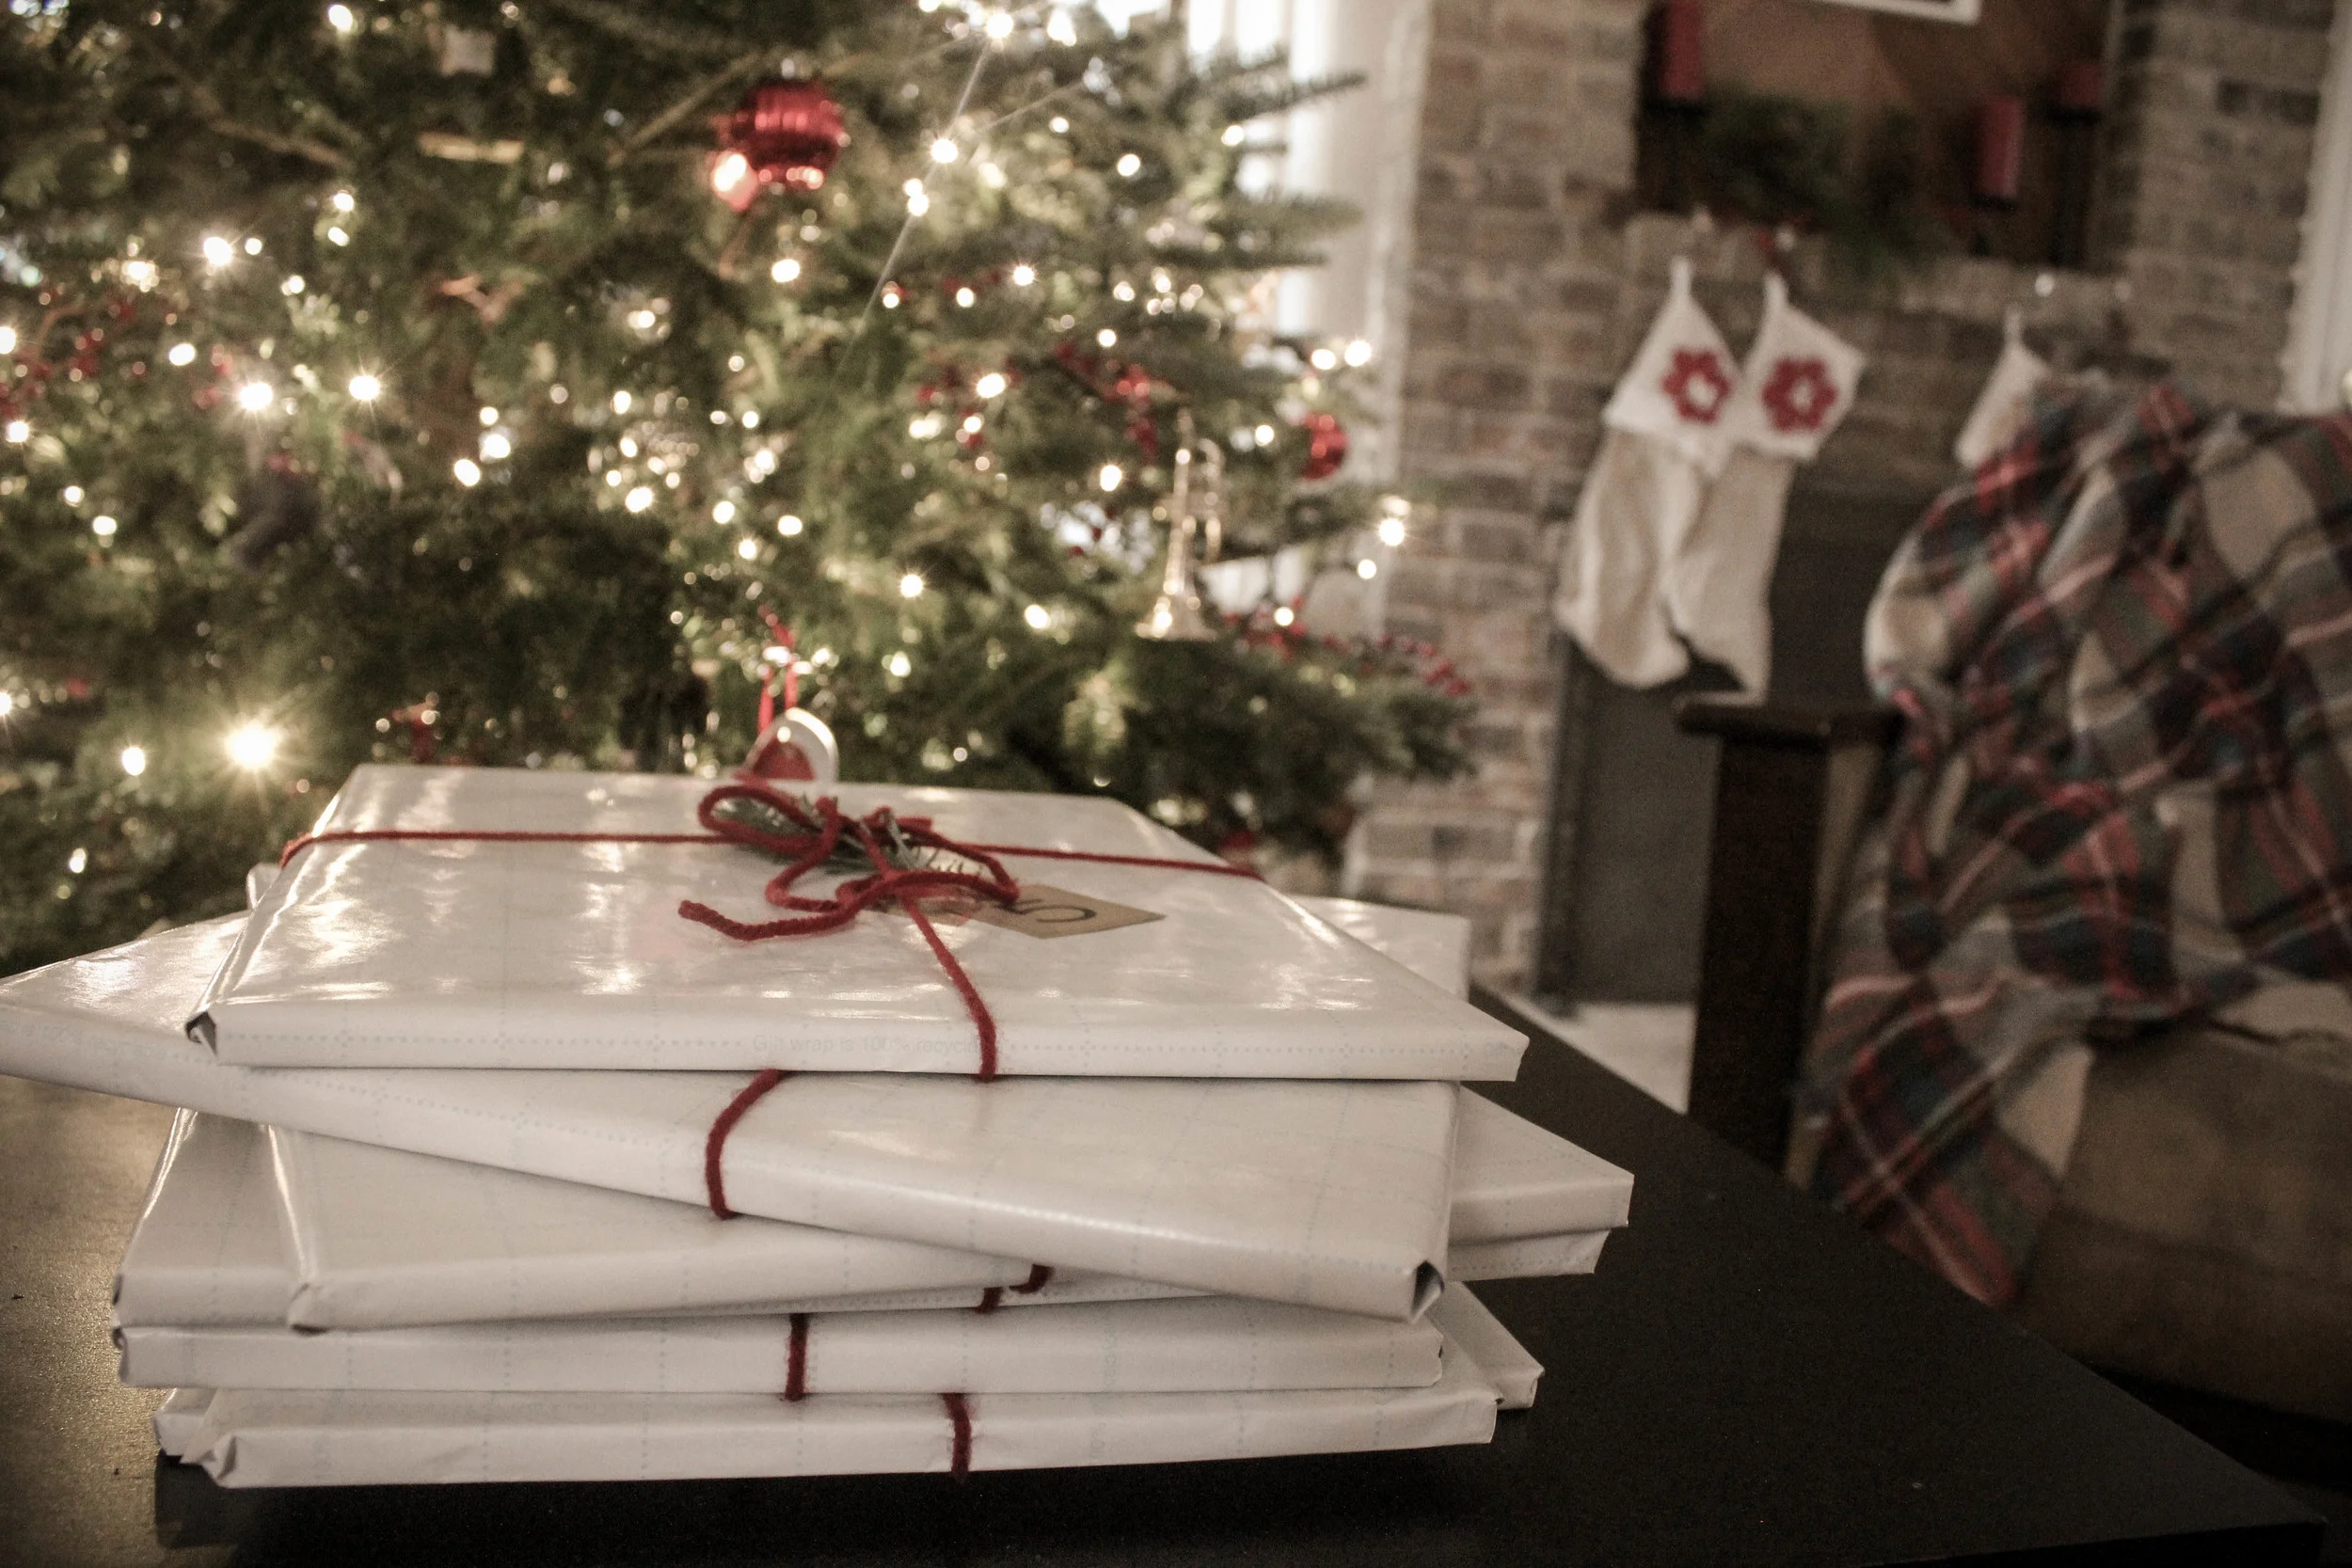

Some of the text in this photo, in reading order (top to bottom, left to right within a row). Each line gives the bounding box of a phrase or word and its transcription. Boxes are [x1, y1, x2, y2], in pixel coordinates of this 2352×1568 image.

[789, 1037, 834, 1055] wrap
[839, 1035, 855, 1053] is
[862, 1035, 911, 1053] 100%
